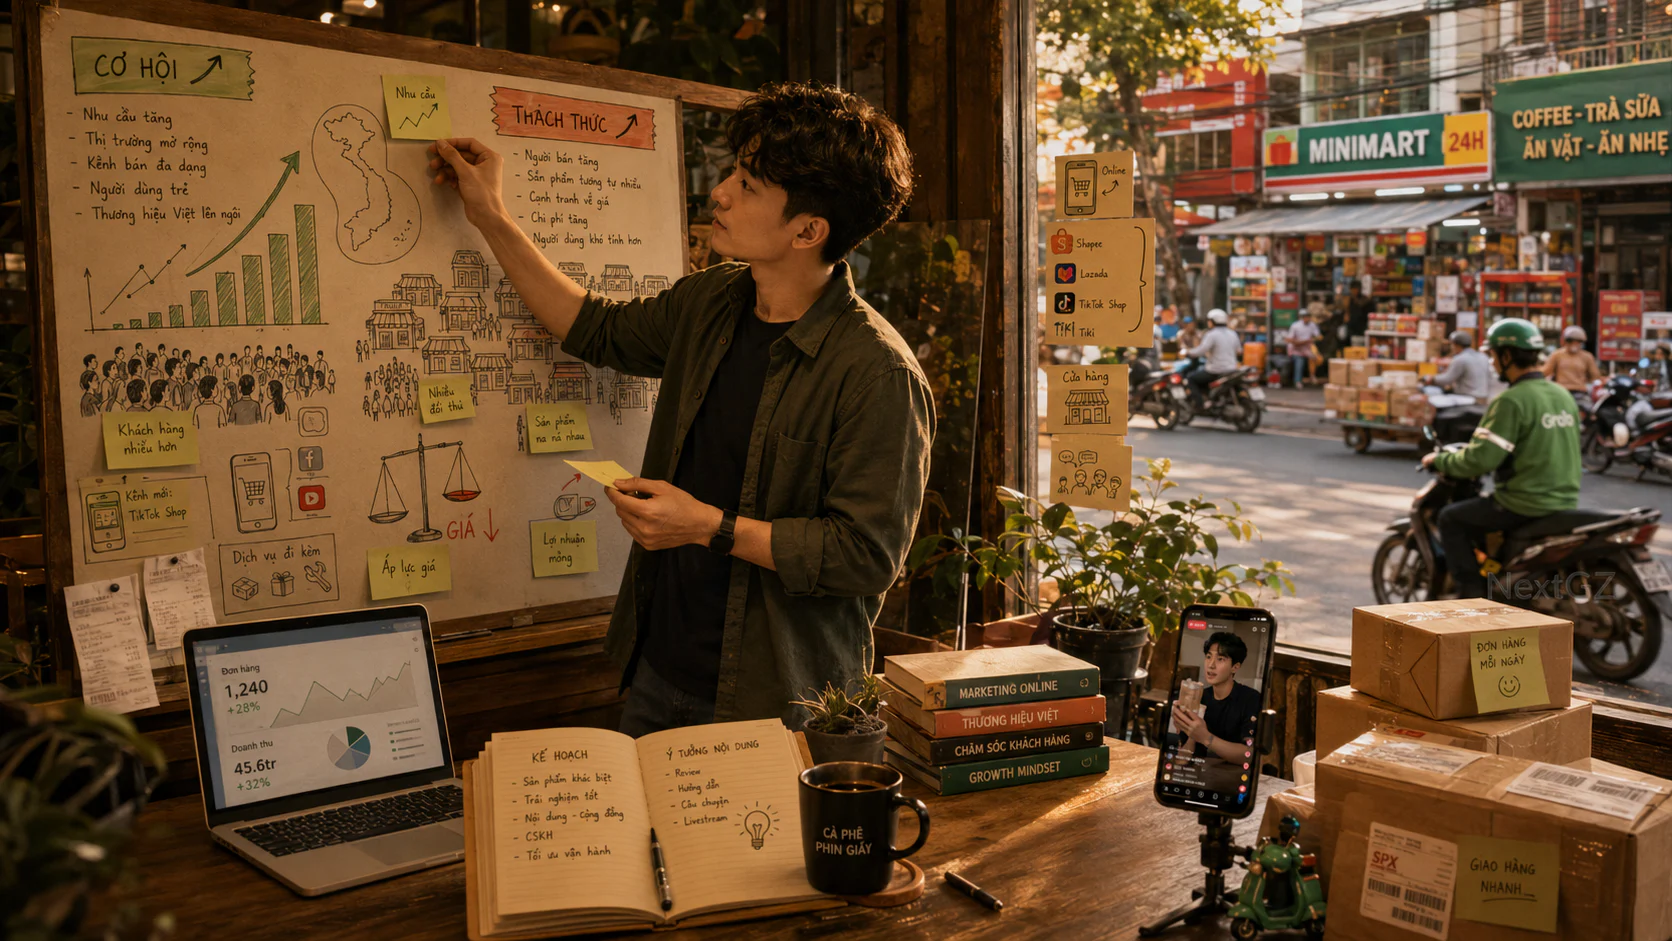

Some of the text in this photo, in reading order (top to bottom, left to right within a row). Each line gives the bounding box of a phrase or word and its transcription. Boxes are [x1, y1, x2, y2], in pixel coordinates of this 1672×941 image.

[94, 51, 177, 84] CƠ HỘI
[396, 86, 416, 99] Nhu
[1624, 92, 1662, 120] SỮA
[83, 107, 108, 121] Nhu
[143, 111, 172, 130] tăng
[511, 103, 607, 133] THÁCH THỨC
[85, 131, 106, 150] Thị
[112, 133, 152, 153] trường
[183, 136, 208, 155] rộng
[1309, 128, 1484, 165] MINIMART 24H
[1522, 129, 1669, 162] ĂN VẶT ĂN NHẸ
[125, 157, 147, 170] bán
[156, 157, 172, 171] đa
[179, 158, 206, 178] dạng
[525, 149, 598, 172] Người bán tăng
[1101, 165, 1126, 176] Online
[90, 181, 125, 201] Người
[134, 181, 163, 201] dùng
[607, 177, 617, 190] tự
[529, 190, 551, 206] Cạnh
[556, 192, 579, 204] tranh
[597, 196, 609, 210] giá
[91, 206, 241, 225] Thương hiệu Việt lên ngôi
[531, 211, 546, 223] Chi
[550, 212, 564, 228] phí
[564, 232, 584, 249] dùng
[589, 233, 603, 244] khó
[608, 233, 624, 245] tính
[628, 234, 642, 245] hơn
[1076, 238, 1103, 251] Shopee
[1080, 268, 1108, 279] Lazada
[1078, 299, 1127, 313] TikTok Shop
[1085, 370, 1109, 386] hàng
[118, 421, 184, 439] Khách hàng
[551, 432, 562, 442] ná
[566, 430, 585, 441] nhau
[158, 440, 177, 452] hơn
[125, 489, 148, 502] Kênh
[128, 505, 187, 521] TikTok Shop
[447, 512, 475, 540] GIÁ
[543, 532, 585, 548] Lợi nhuận
[233, 543, 321, 567] Dịch vụ đi kèm
[382, 553, 436, 578] Áp lực giá
[1477, 636, 1526, 653] ĐƠN HÀNG
[240, 665, 260, 674] hàng
[225, 679, 268, 699] 1,240
[959, 680, 1058, 699] MARKETING ONLINE
[227, 701, 261, 714] +28%
[962, 707, 1059, 729] THƯƠNG HIỆU VIỆT
[231, 740, 273, 753] Doanh thu
[666, 746, 673, 761] Ý
[714, 742, 730, 755] NỘI
[735, 740, 759, 751] DUNG
[987, 739, 1007, 753] SÓC
[532, 748, 588, 763] KẾ HOẠCH
[234, 758, 277, 775] 45.6tr
[675, 768, 701, 777] Review
[969, 760, 1061, 784] GROWTH MINDSET
[237, 776, 271, 791] +32%
[595, 772, 612, 784] biệt
[548, 792, 579, 806] nghiệm
[546, 811, 567, 824] dung
[684, 814, 728, 826] Livestream
[525, 830, 553, 842] CSKH
[823, 825, 864, 840] CÀ PHÊ
[564, 847, 581, 860] vận
[587, 845, 611, 856] hành
[815, 840, 873, 856] PHIN GIẤY
[1372, 851, 1398, 869] SPX
[1470, 857, 1536, 875] GIAO HÀNG
[1480, 880, 1521, 895] NHANH
